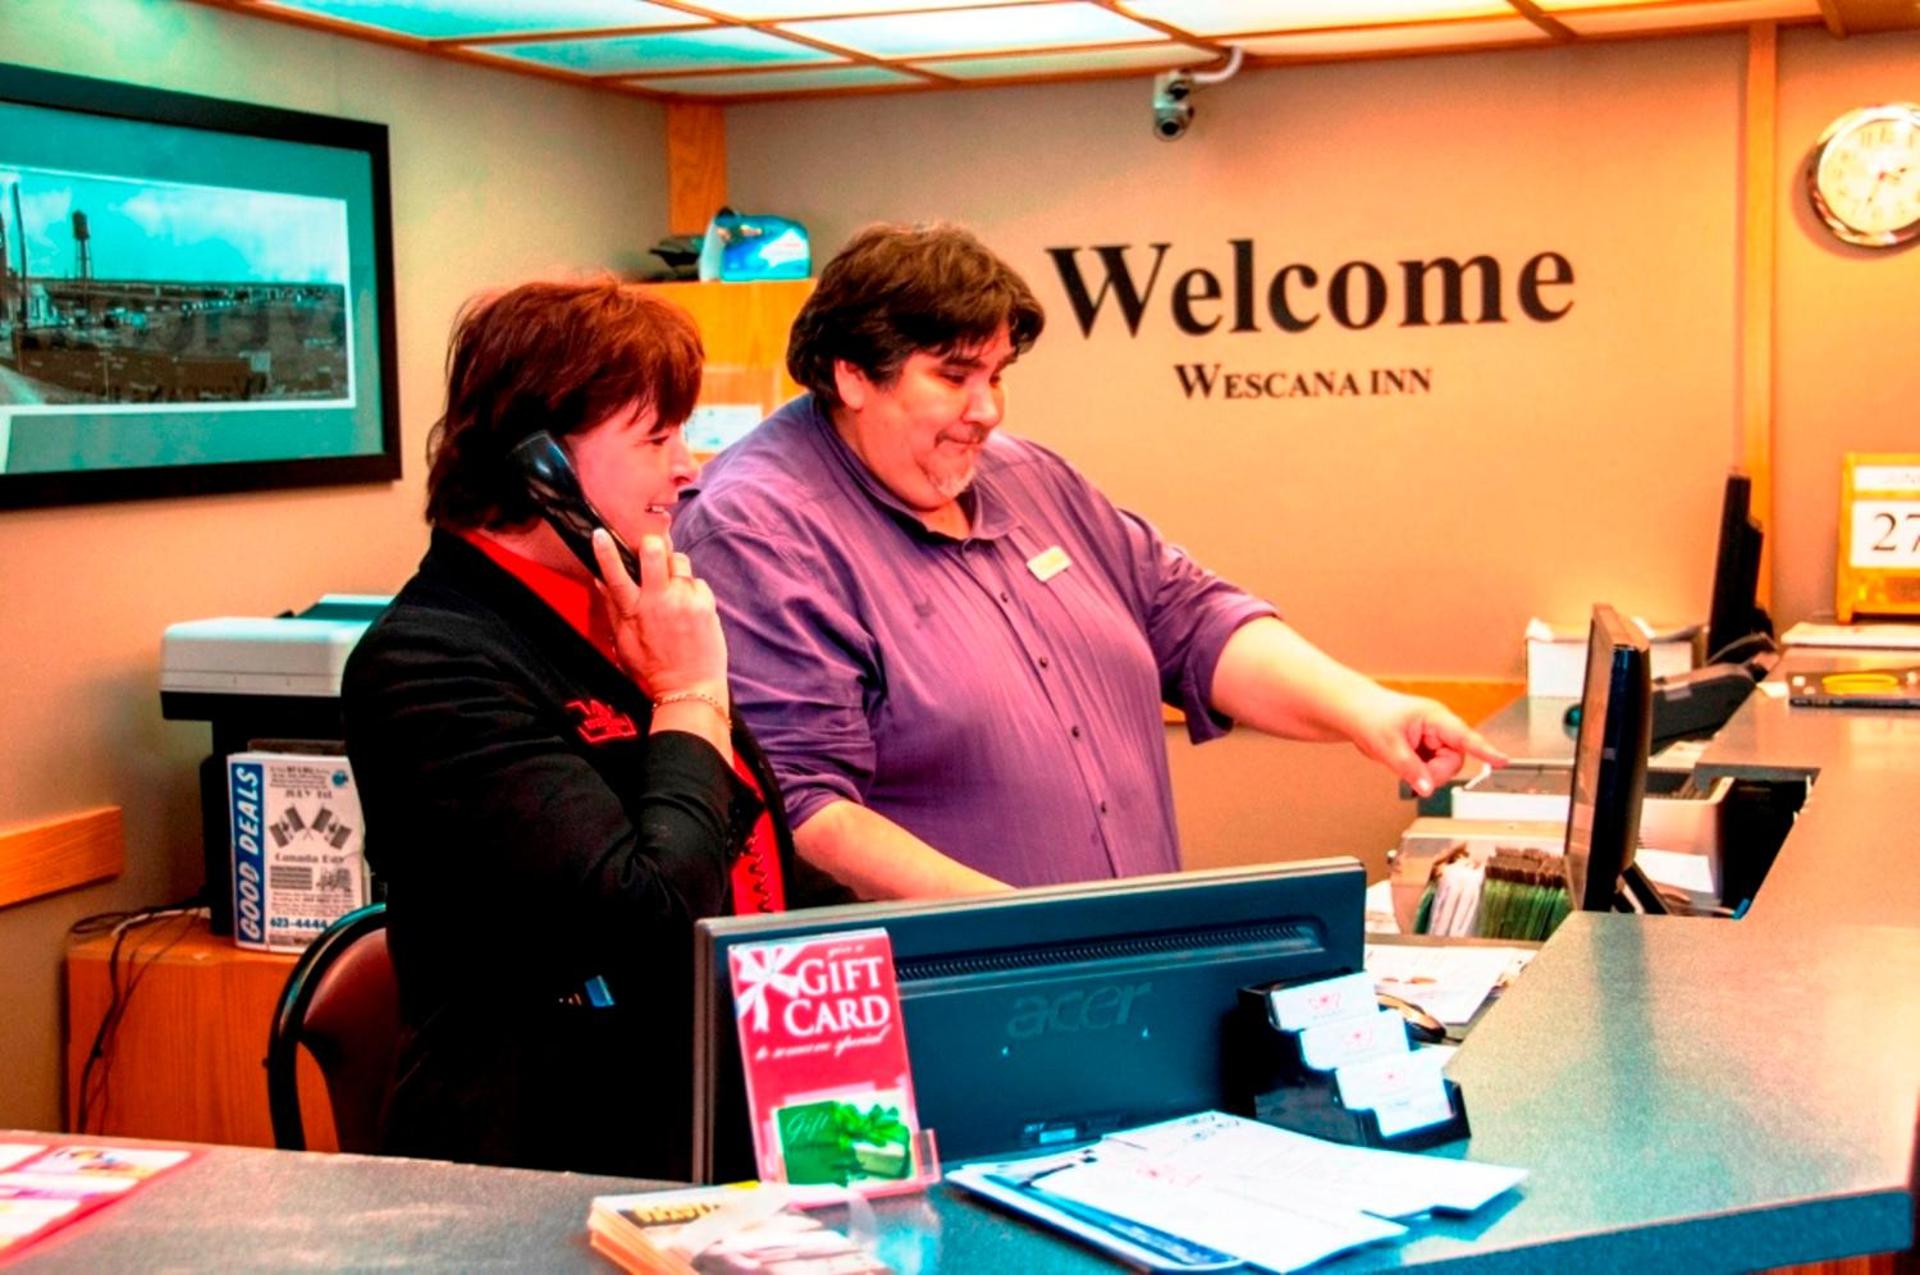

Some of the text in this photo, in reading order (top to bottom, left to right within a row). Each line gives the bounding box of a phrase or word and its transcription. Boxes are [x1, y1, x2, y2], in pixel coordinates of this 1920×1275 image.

[1044, 238, 1575, 340] Welcome
[1173, 362, 1433, 401] WESCANA INN
[1872, 512, 1920, 551] 27
[236, 767, 261, 939] GOOD DEALS
[796, 955, 884, 996] GIFT
[783, 994, 892, 1038] CARD
[1007, 982, 1153, 1038] acer
